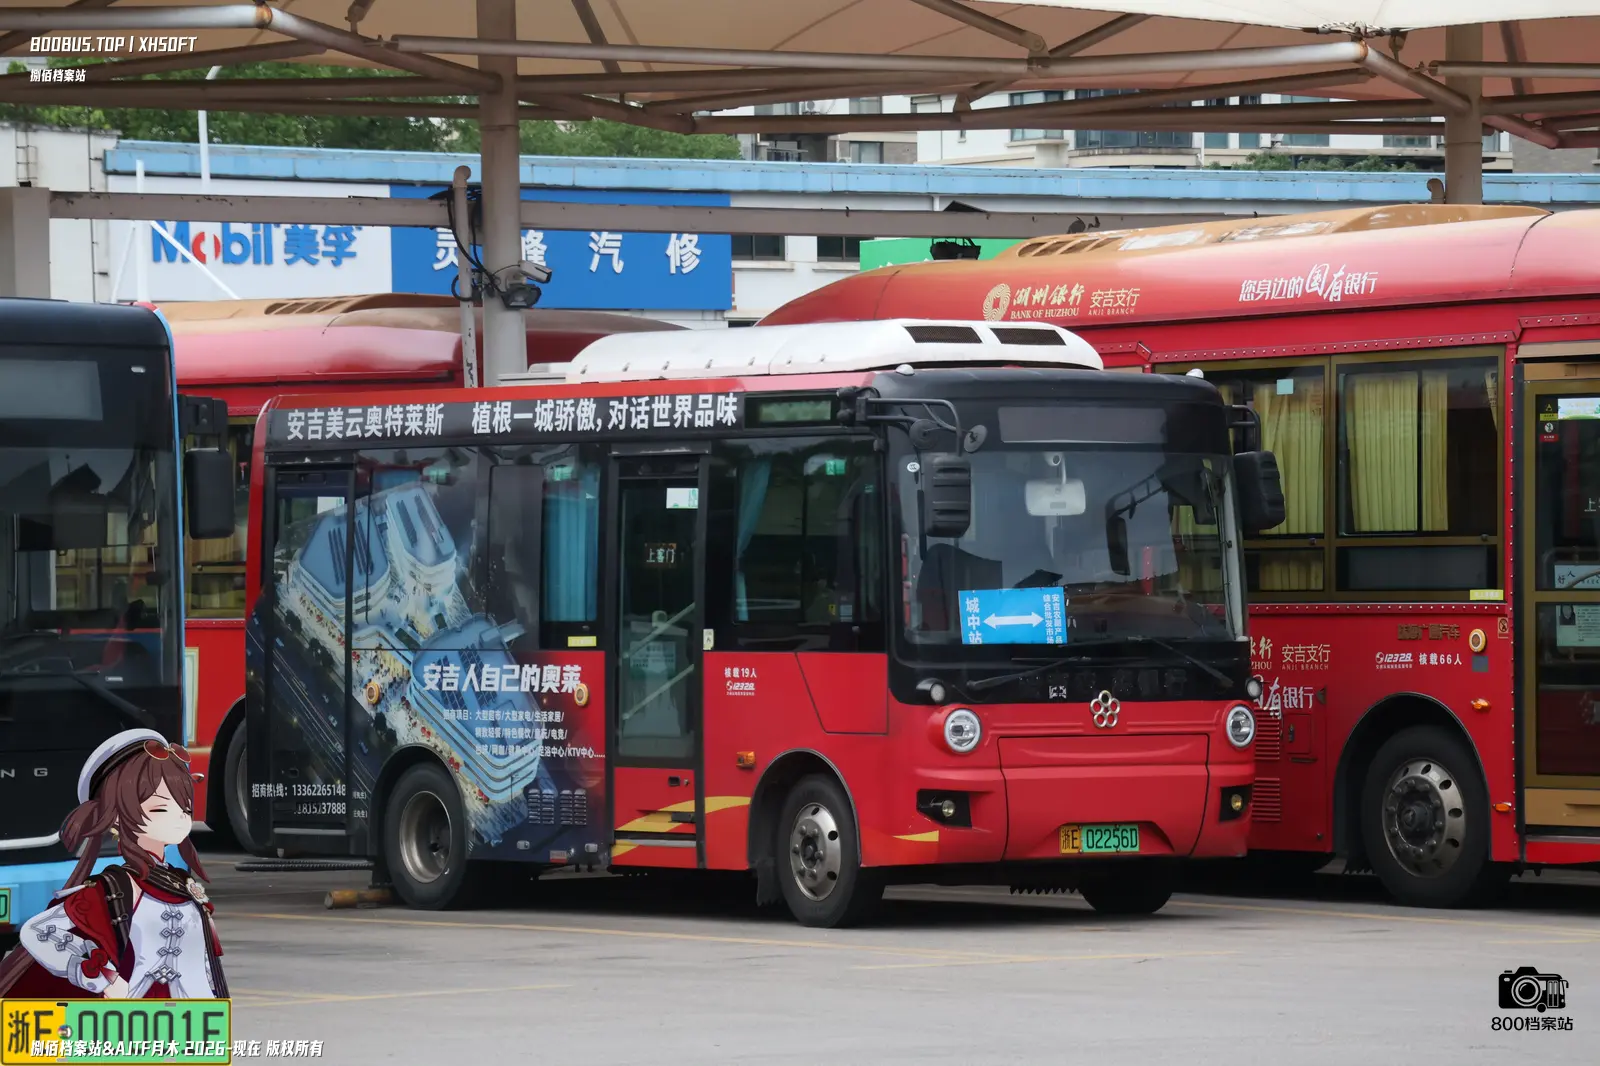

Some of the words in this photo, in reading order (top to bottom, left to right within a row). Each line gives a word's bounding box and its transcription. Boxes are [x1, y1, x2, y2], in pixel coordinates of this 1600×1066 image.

[152, 221, 273, 265] Mobil
[284, 225, 357, 267] 美孚
[1089, 288, 1141, 309] 安吉支行
[1010, 310, 1032, 320] BANK
[1033, 309, 1043, 319] OF
[1045, 308, 1080, 318] HUZHOU
[1107, 307, 1135, 316] BRANCH
[287, 403, 445, 440] 安吉美云奥特莱斯
[471, 392, 738, 434] 植根一城骄傲，对话世界品味
[966, 597, 982, 644] 城中站
[1281, 644, 1331, 663] 安吉支行
[1384, 653, 1413, 663] 12328
[1419, 652, 1462, 666] 核载66人
[423, 663, 582, 694] 安吉人自己的奥莱
